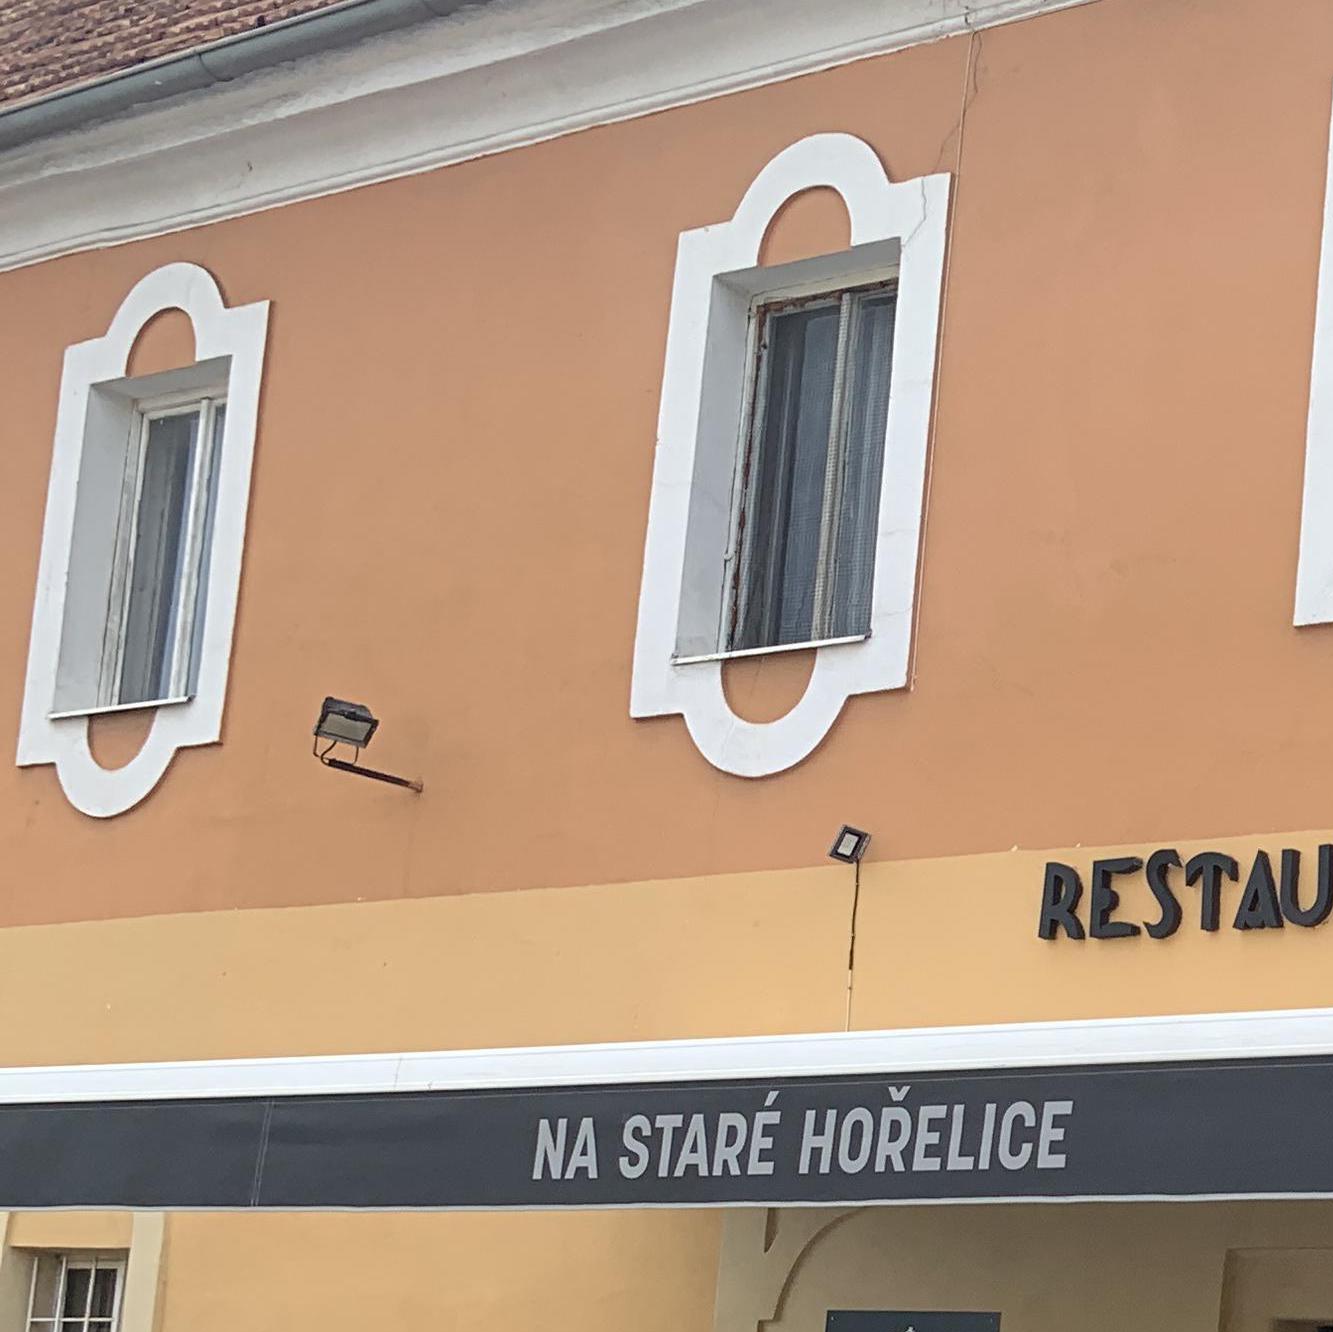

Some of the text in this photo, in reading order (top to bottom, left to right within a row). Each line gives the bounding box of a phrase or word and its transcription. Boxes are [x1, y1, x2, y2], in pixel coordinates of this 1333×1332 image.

[531, 1085, 1075, 1180] NA STARÉ HOŘELICE
